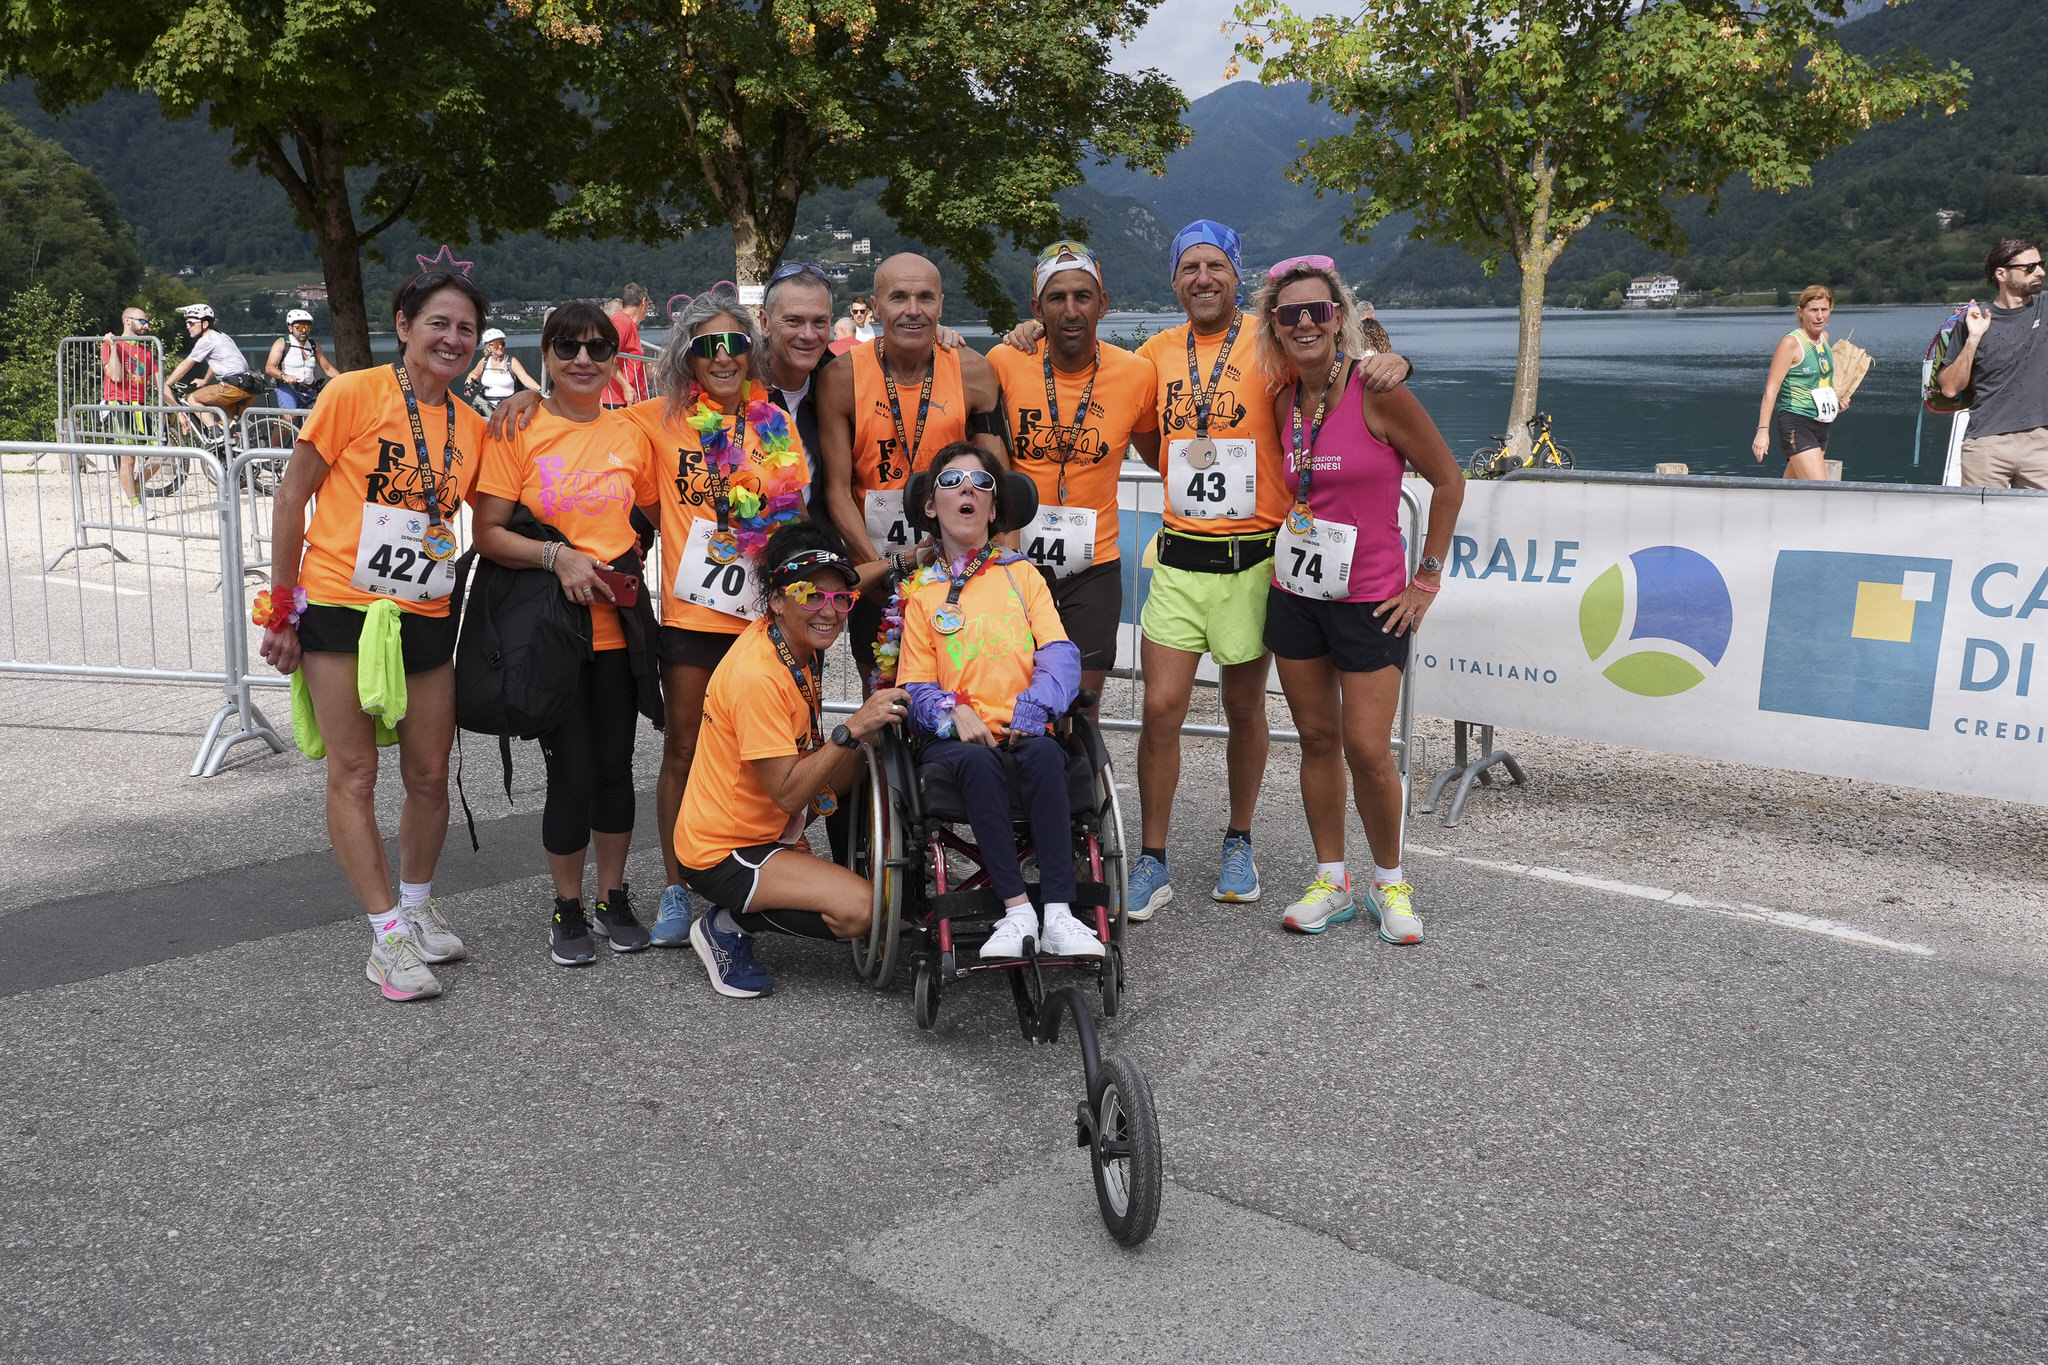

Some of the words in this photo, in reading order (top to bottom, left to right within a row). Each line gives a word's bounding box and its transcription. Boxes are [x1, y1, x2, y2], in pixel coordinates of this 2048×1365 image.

[1188, 347, 1197, 368] 2026
[1218, 342, 1232, 363] 2026
[396, 366, 412, 391] 2026
[1328, 360, 1342, 383] 2026
[886, 376, 897, 400] 2026
[921, 376, 932, 400] 2026
[1046, 378, 1055, 401] 2026
[1192, 384, 1204, 406] 2026
[1205, 382, 1217, 404] 2026
[1293, 407, 1302, 429] 2026
[1314, 402, 1326, 425] 2026
[1821, 402, 1836, 416] 414
[410, 413, 424, 440] 2026
[420, 462, 434, 489] 2026
[711, 474, 722, 498] 2026
[1187, 472, 1227, 503] 43
[1027, 536, 1067, 566] 44
[368, 543, 438, 585] 427
[963, 558, 982, 577] 2026
[1290, 546, 1323, 584] 74
[701, 556, 746, 597] 70
[777, 641, 796, 667] 2026
[1450, 657, 1558, 685] ITALIANO
[1959, 637, 2036, 697] DI
